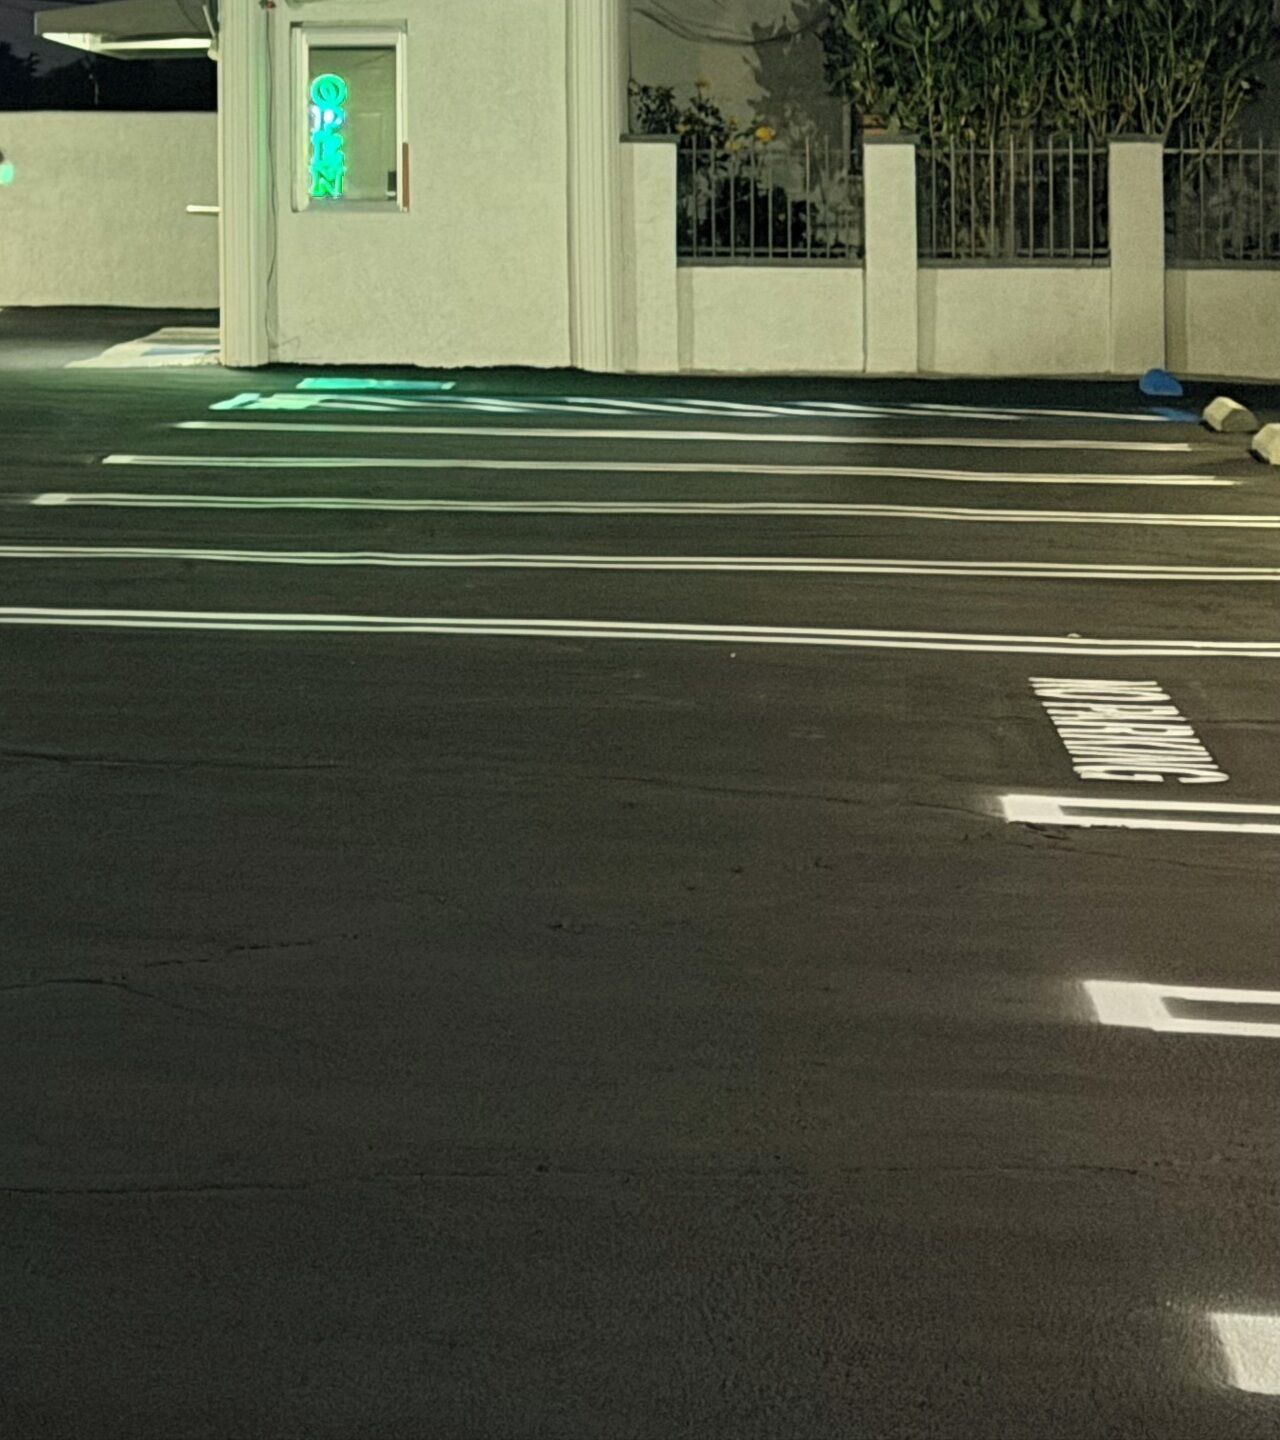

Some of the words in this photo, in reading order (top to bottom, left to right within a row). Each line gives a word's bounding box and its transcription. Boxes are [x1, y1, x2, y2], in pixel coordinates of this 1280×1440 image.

[310, 74, 347, 198] OPEN
[1028, 677, 1171, 701] NO
[1041, 701, 1230, 783] PARKING
